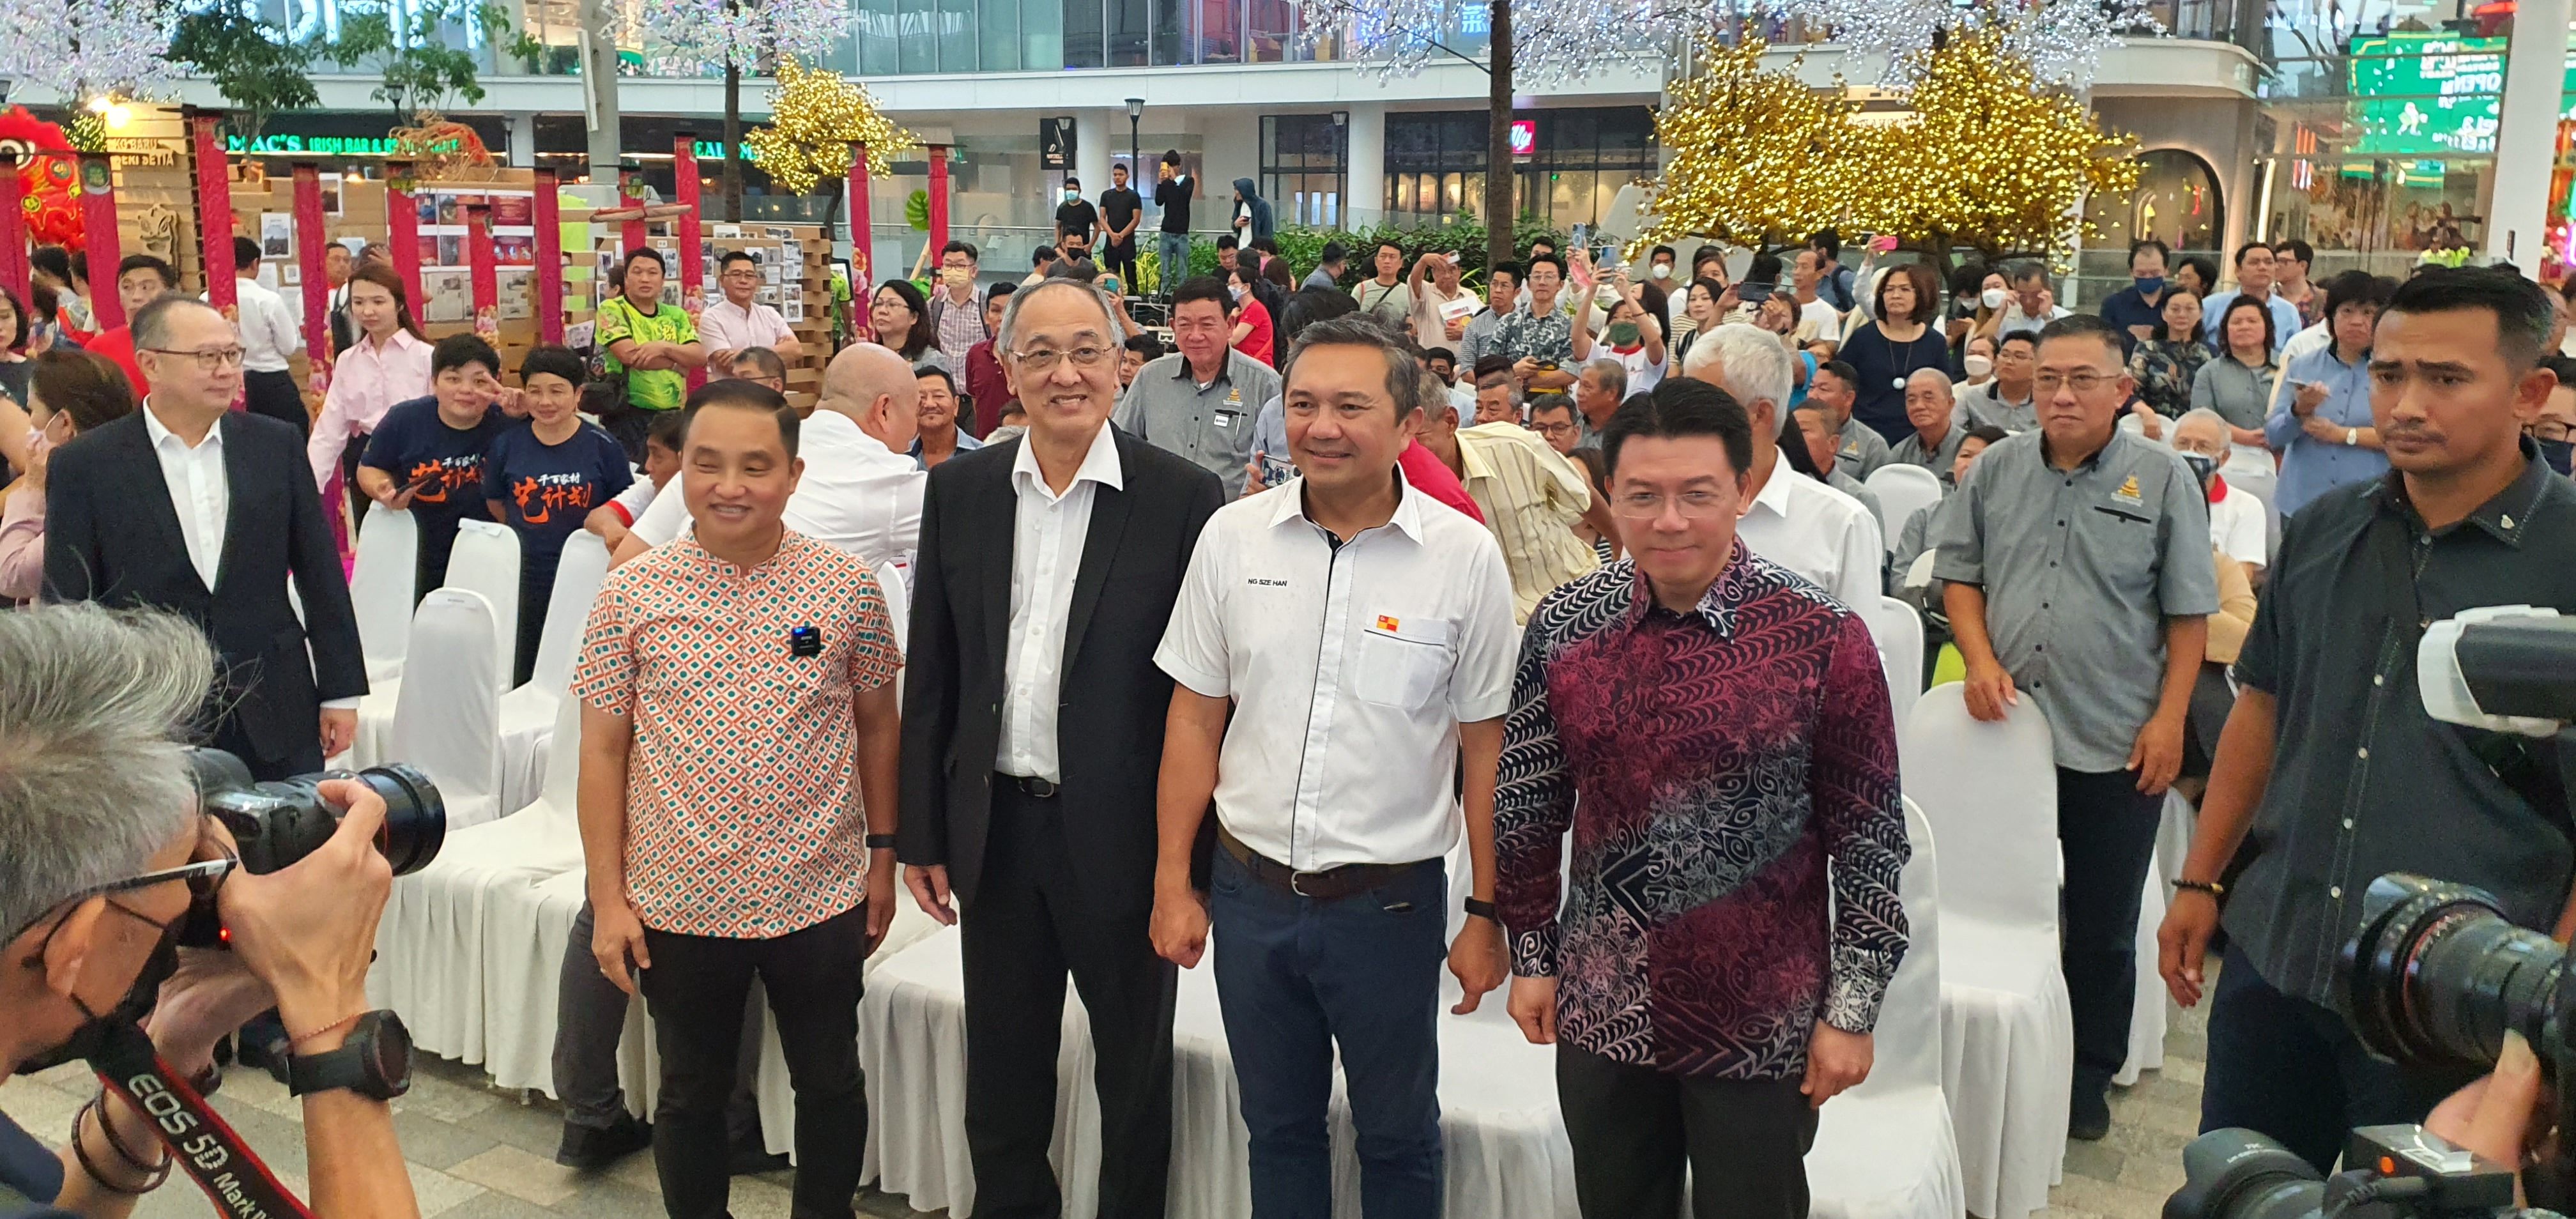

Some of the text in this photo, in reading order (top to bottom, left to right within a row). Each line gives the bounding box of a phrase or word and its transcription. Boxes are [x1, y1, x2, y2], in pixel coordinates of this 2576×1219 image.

[227, 134, 302, 151] MAC'S
[309, 137, 342, 153] IRISH
[344, 137, 369, 153] BAR
[1512, 123, 1533, 151] lly
[695, 141, 726, 157] EAL
[128, 1073, 198, 1135] EOS
[183, 1133, 229, 1169] 5D
[213, 1172, 256, 1219] Mark
